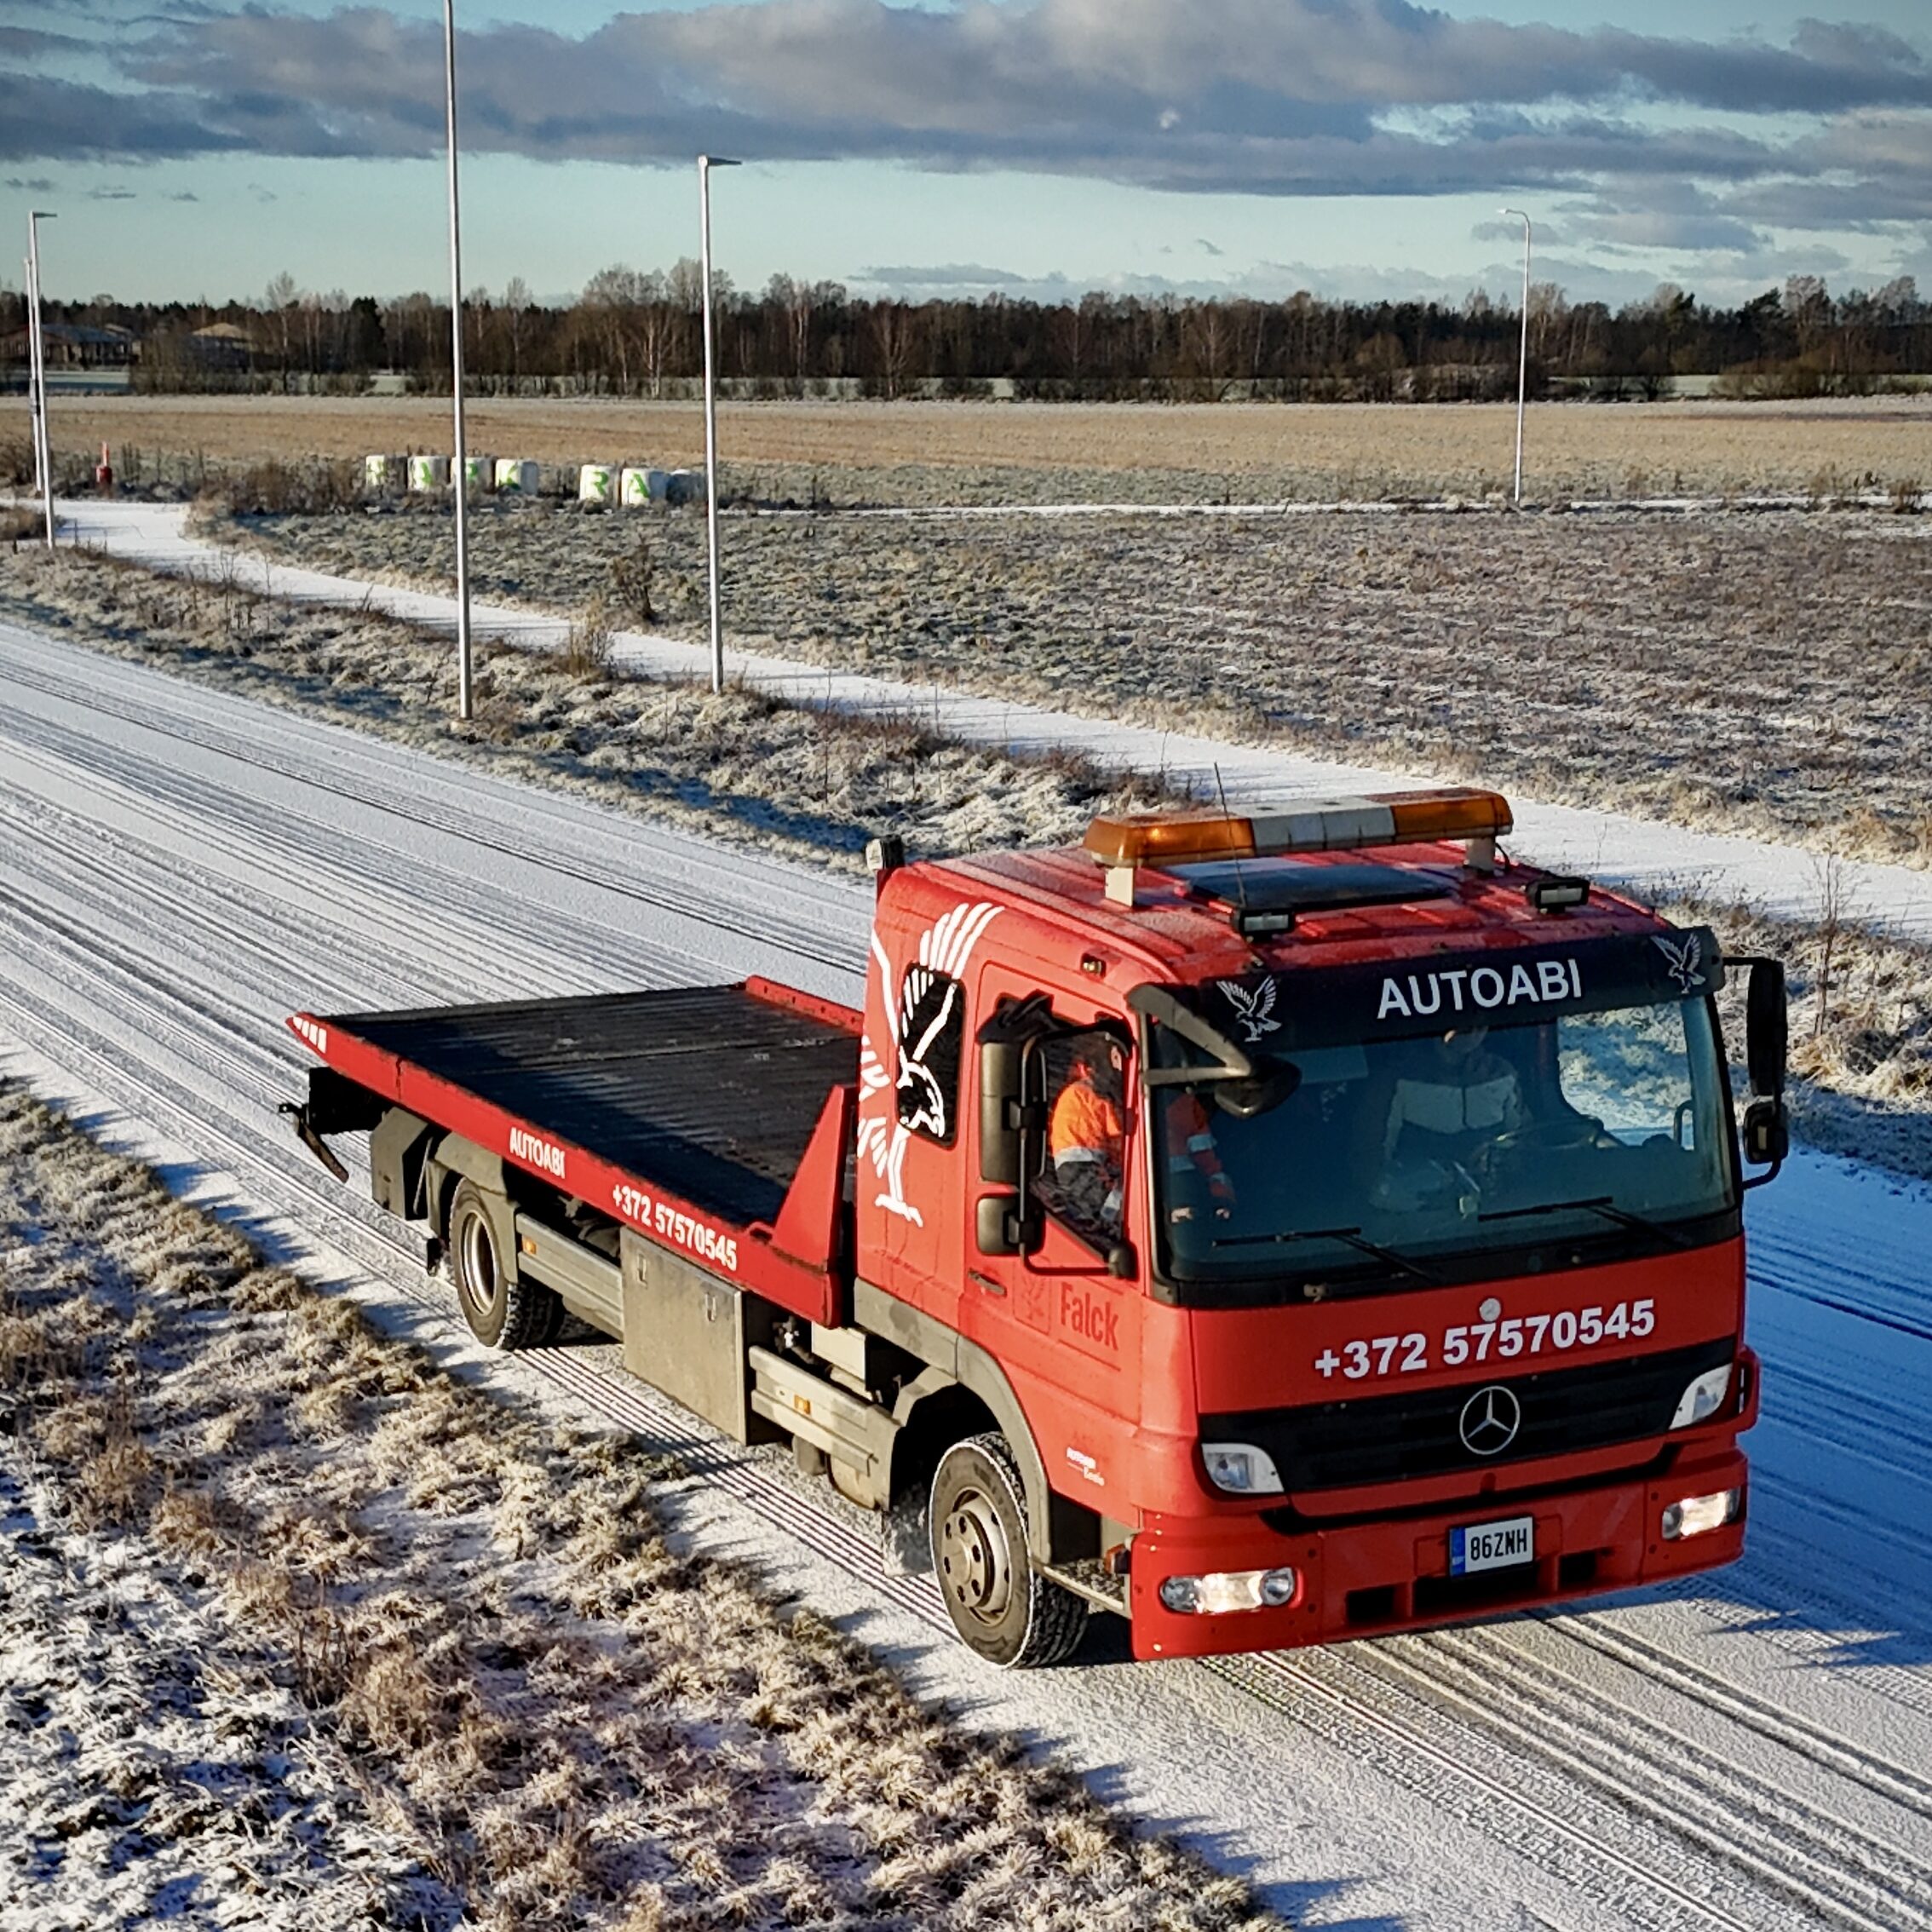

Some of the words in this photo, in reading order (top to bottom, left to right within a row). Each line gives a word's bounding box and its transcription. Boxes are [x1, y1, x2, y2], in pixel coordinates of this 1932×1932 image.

[1377, 958, 1582, 1019] AUTOABI
[509, 1127, 566, 1179] AUTOABI
[612, 1184, 653, 1228] +372
[655, 1202, 738, 1271] 57570545
[1061, 1282, 1118, 1351] Falck
[1315, 1333, 1427, 1378] +372
[1443, 1299, 1655, 1365] 57570545
[1470, 1527, 1527, 1561] 86ZNH
